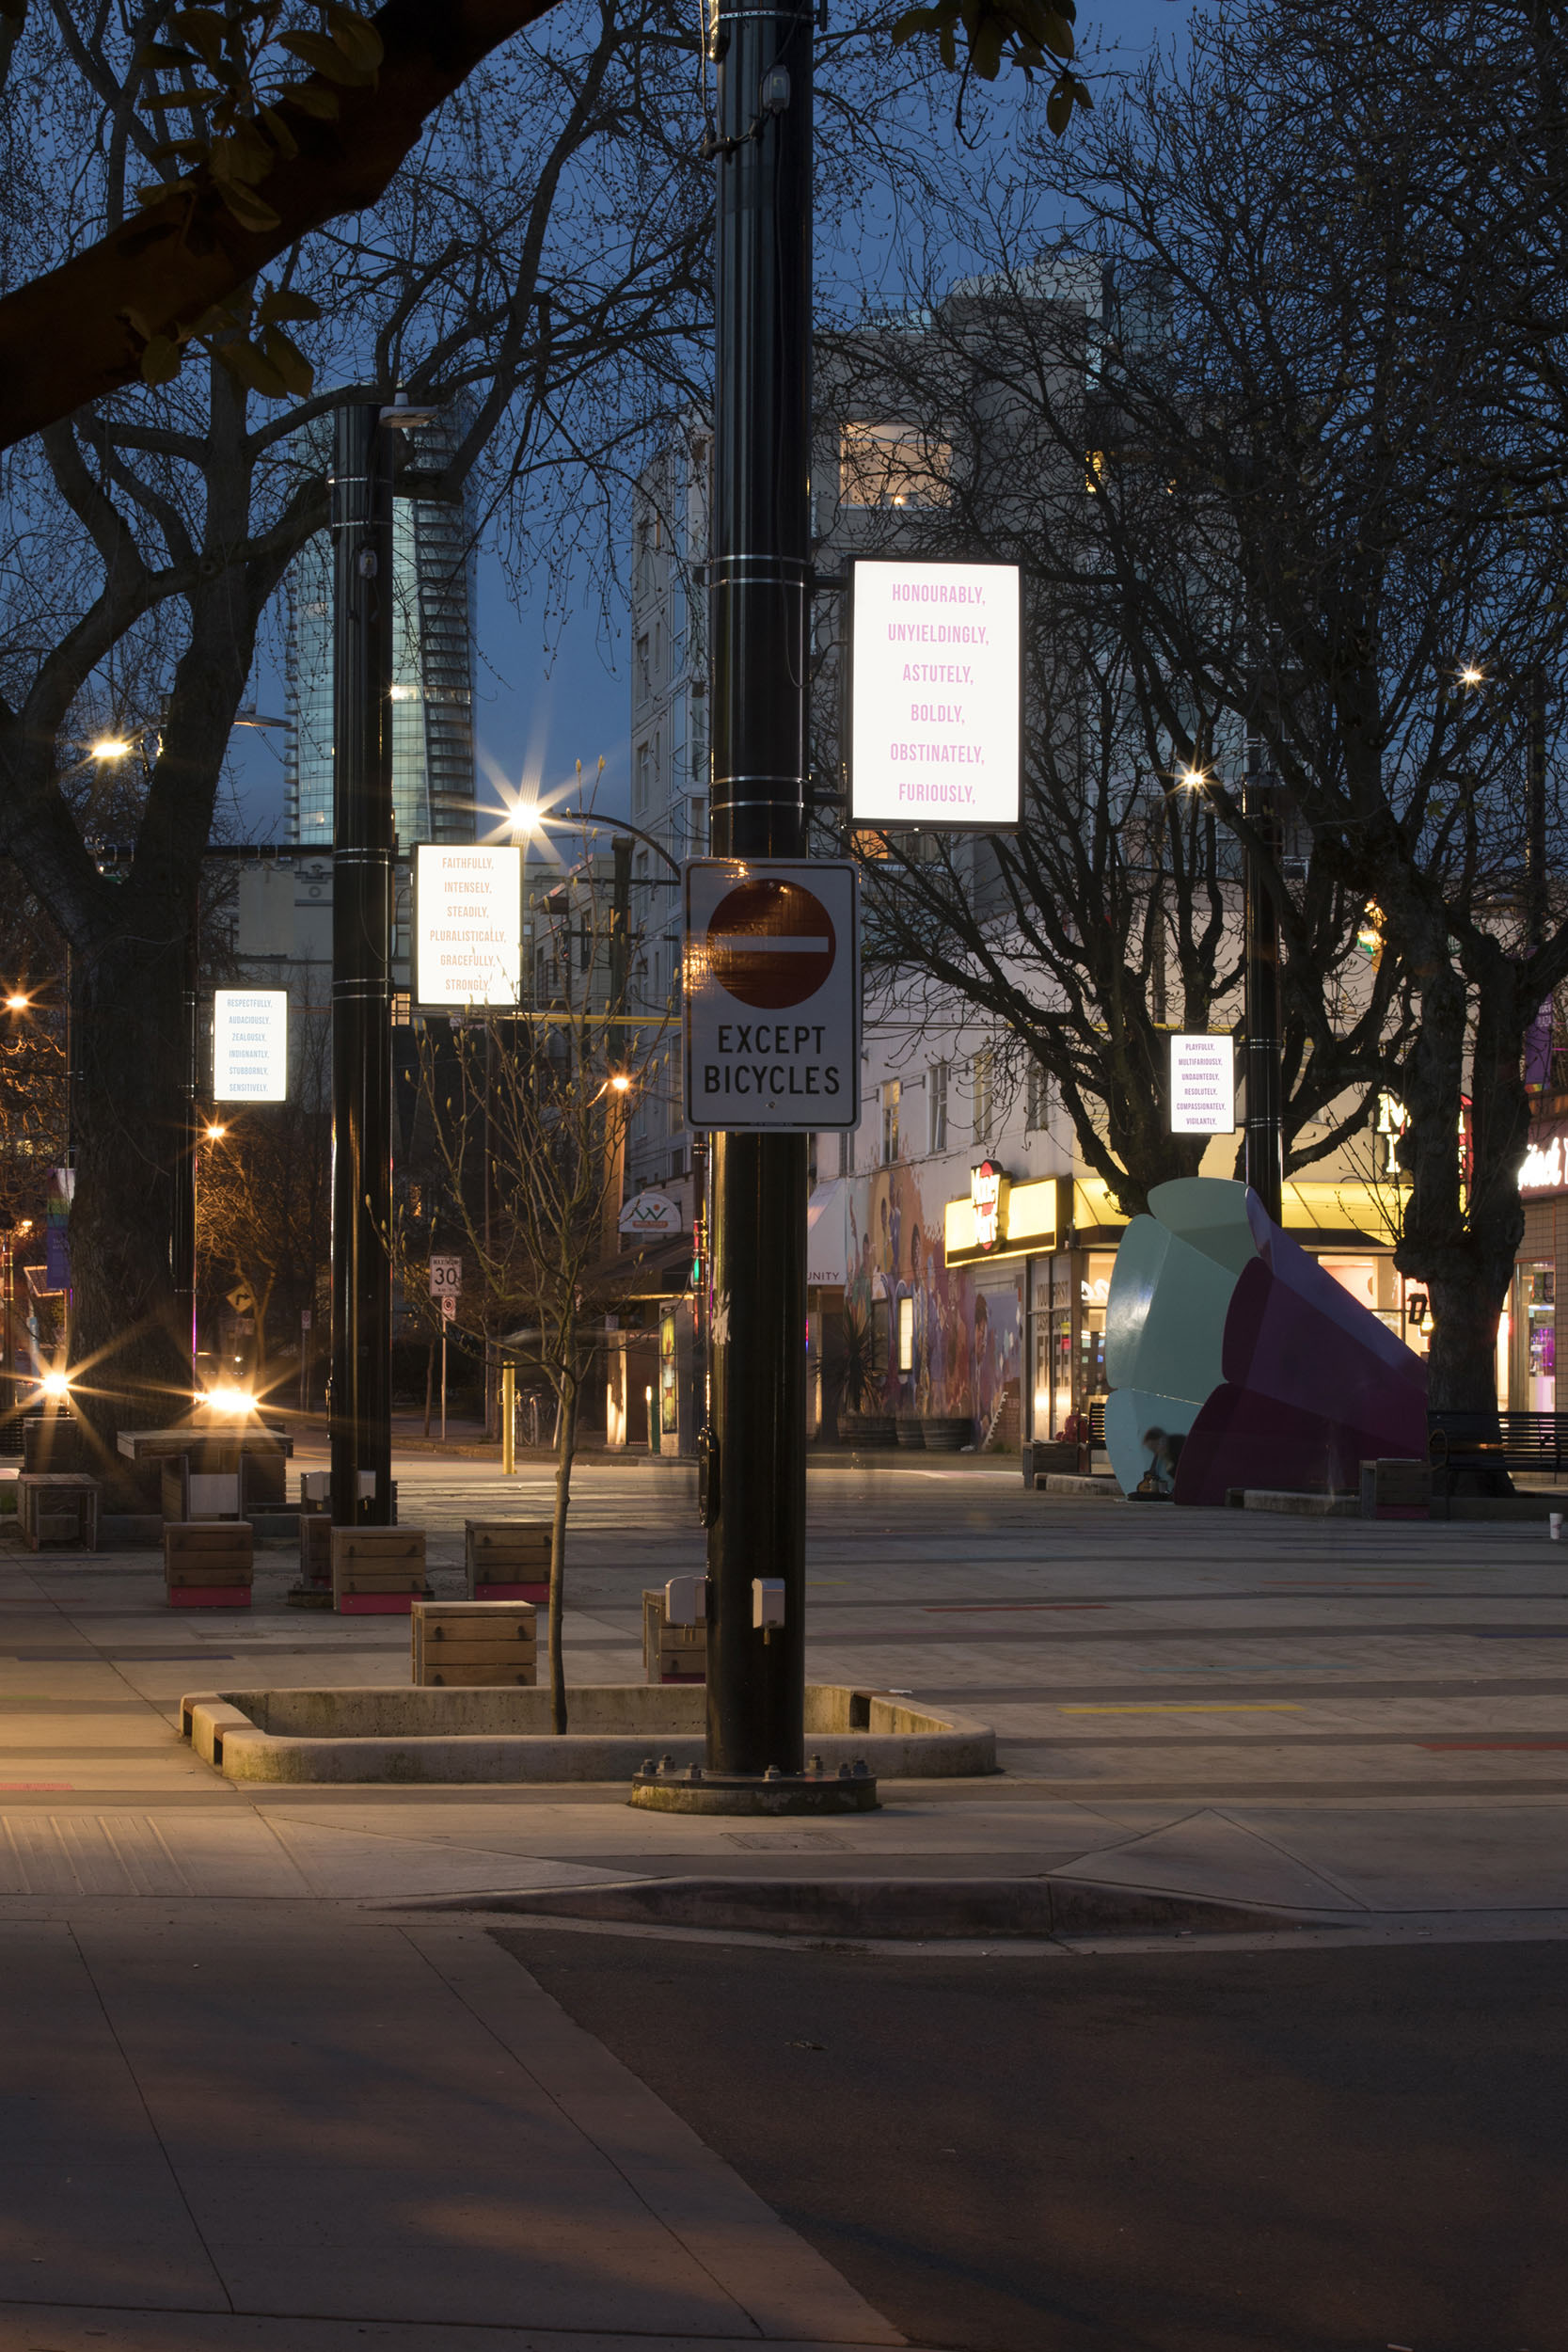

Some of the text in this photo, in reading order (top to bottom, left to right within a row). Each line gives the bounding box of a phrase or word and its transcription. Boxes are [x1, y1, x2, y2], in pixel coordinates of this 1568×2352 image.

[893, 583, 986, 605] HONOURABLY,
[888, 624, 990, 646] UNYIELDINGLY,
[903, 664, 974, 685] ASTUTELY,
[911, 704, 965, 724] BOLDLY,
[891, 743, 985, 765] OBSTINATELY,
[899, 784, 976, 804] FURIOUSLY,
[442, 857, 494, 869] FAITHFULLY,
[444, 882, 492, 895] INTENSELY,
[447, 906, 489, 918] STEADILY,
[430, 930, 507, 944] PLURALISTICALLY,
[440, 954, 496, 967] GRACEFULLY,
[718, 1025, 826, 1055] EXCEPT
[704, 1065, 840, 1095] BICYCLES
[434, 1267, 457, 1285] 30
